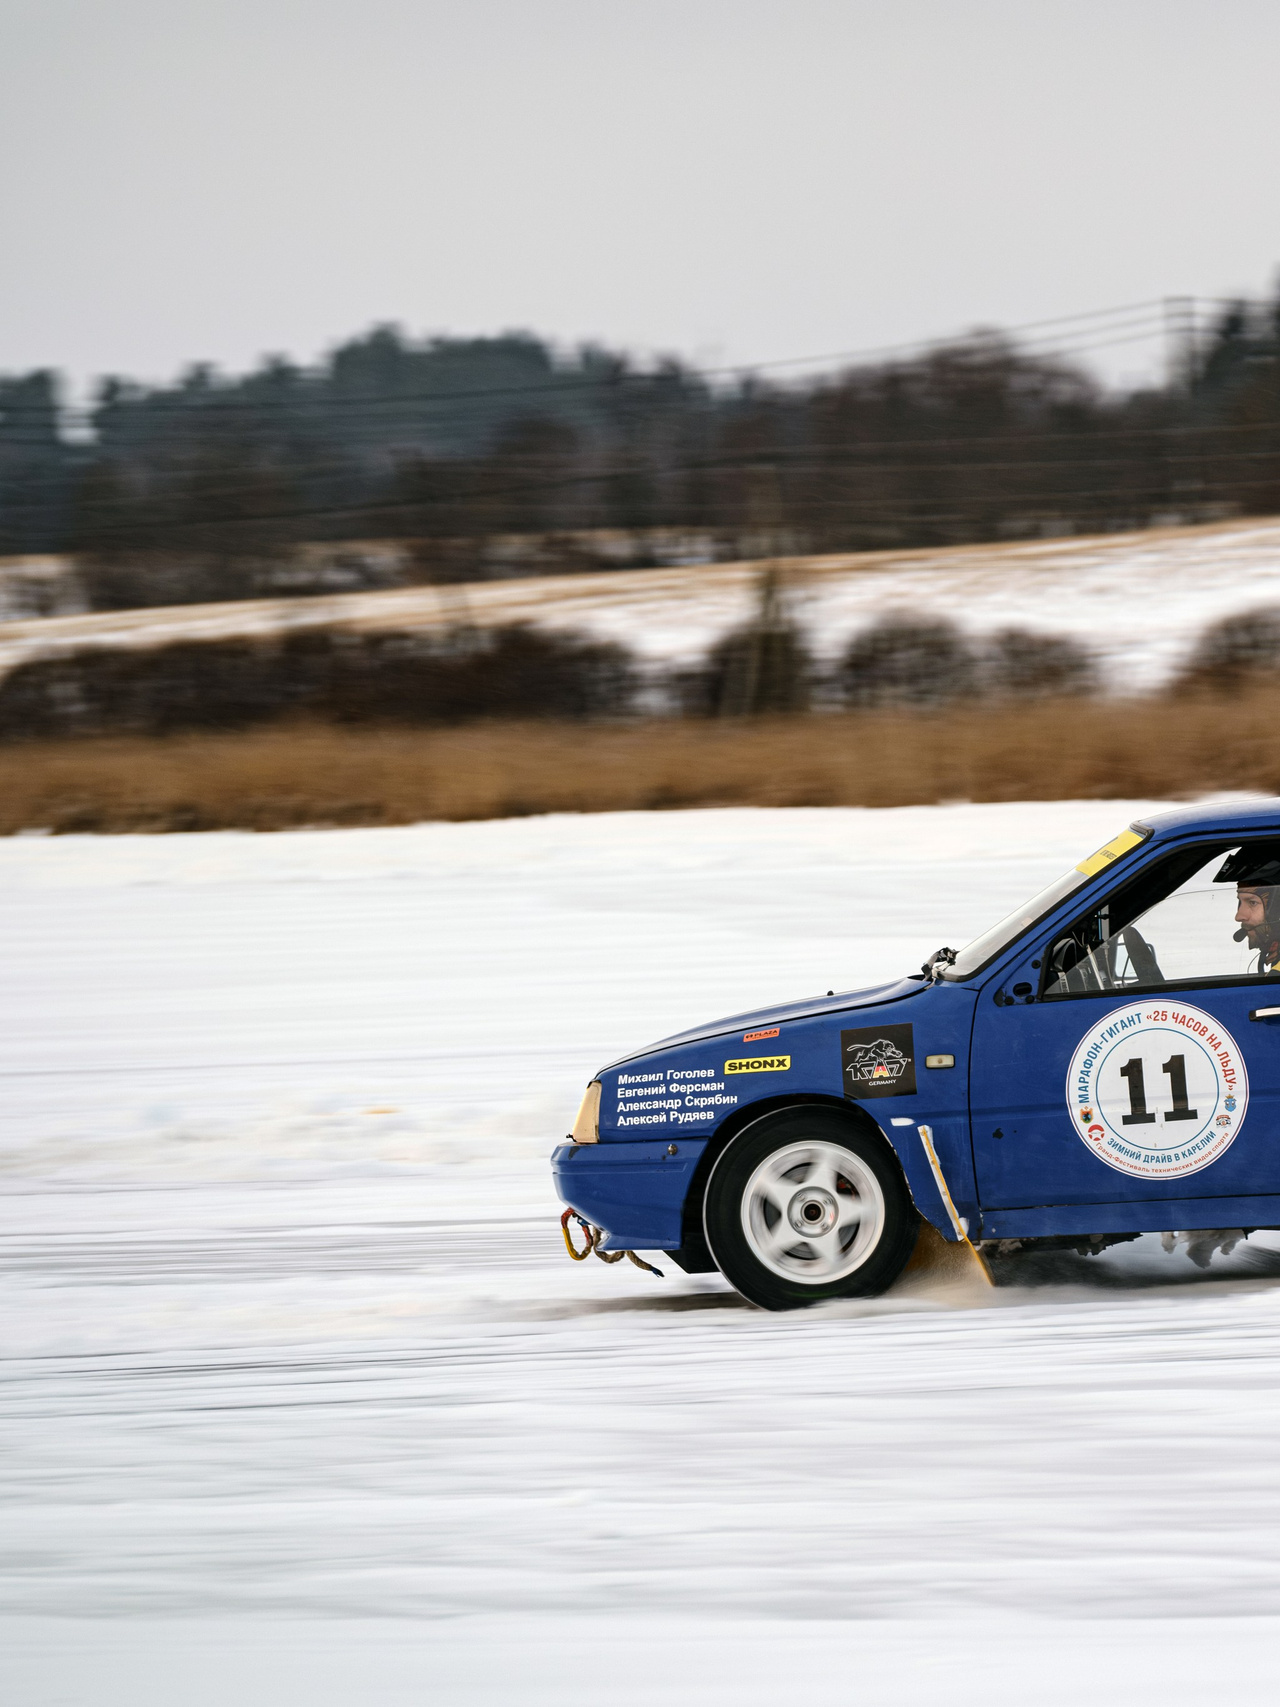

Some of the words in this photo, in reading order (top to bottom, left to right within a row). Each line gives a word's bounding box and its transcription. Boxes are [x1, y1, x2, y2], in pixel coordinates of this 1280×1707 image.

[728, 1058, 787, 1071] SHONX
[1077, 1012, 1143, 1104] МАРАФОН-ГИГАНТ
[1146, 1010, 1168, 1022] «25
[1171, 1011, 1208, 1037] ЧАСОВ
[1206, 1033, 1223, 1051] НА
[1217, 1051, 1237, 1091] ЛЬДУ»
[618, 1073, 663, 1085] Михаил
[666, 1069, 715, 1080] Гоголев
[617, 1084, 666, 1098] Евгений
[669, 1082, 725, 1094] Ферсман
[1120, 1054, 1198, 1126] 11
[617, 1098, 682, 1112] Александр
[685, 1094, 738, 1108] Скрябин
[617, 1112, 667, 1127] Алексей
[669, 1110, 715, 1124] Рудяев
[1107, 1137, 1141, 1160] ЗИМНИЙ
[1142, 1153, 1173, 1164] ДРАЙВ
[1174, 1153, 1181, 1162] В
[1181, 1130, 1217, 1159] КАРЕЛИИ
[1151, 1162, 1193, 1173] технических
[1193, 1150, 1213, 1164] видов
[1211, 1132, 1230, 1152] спорта
